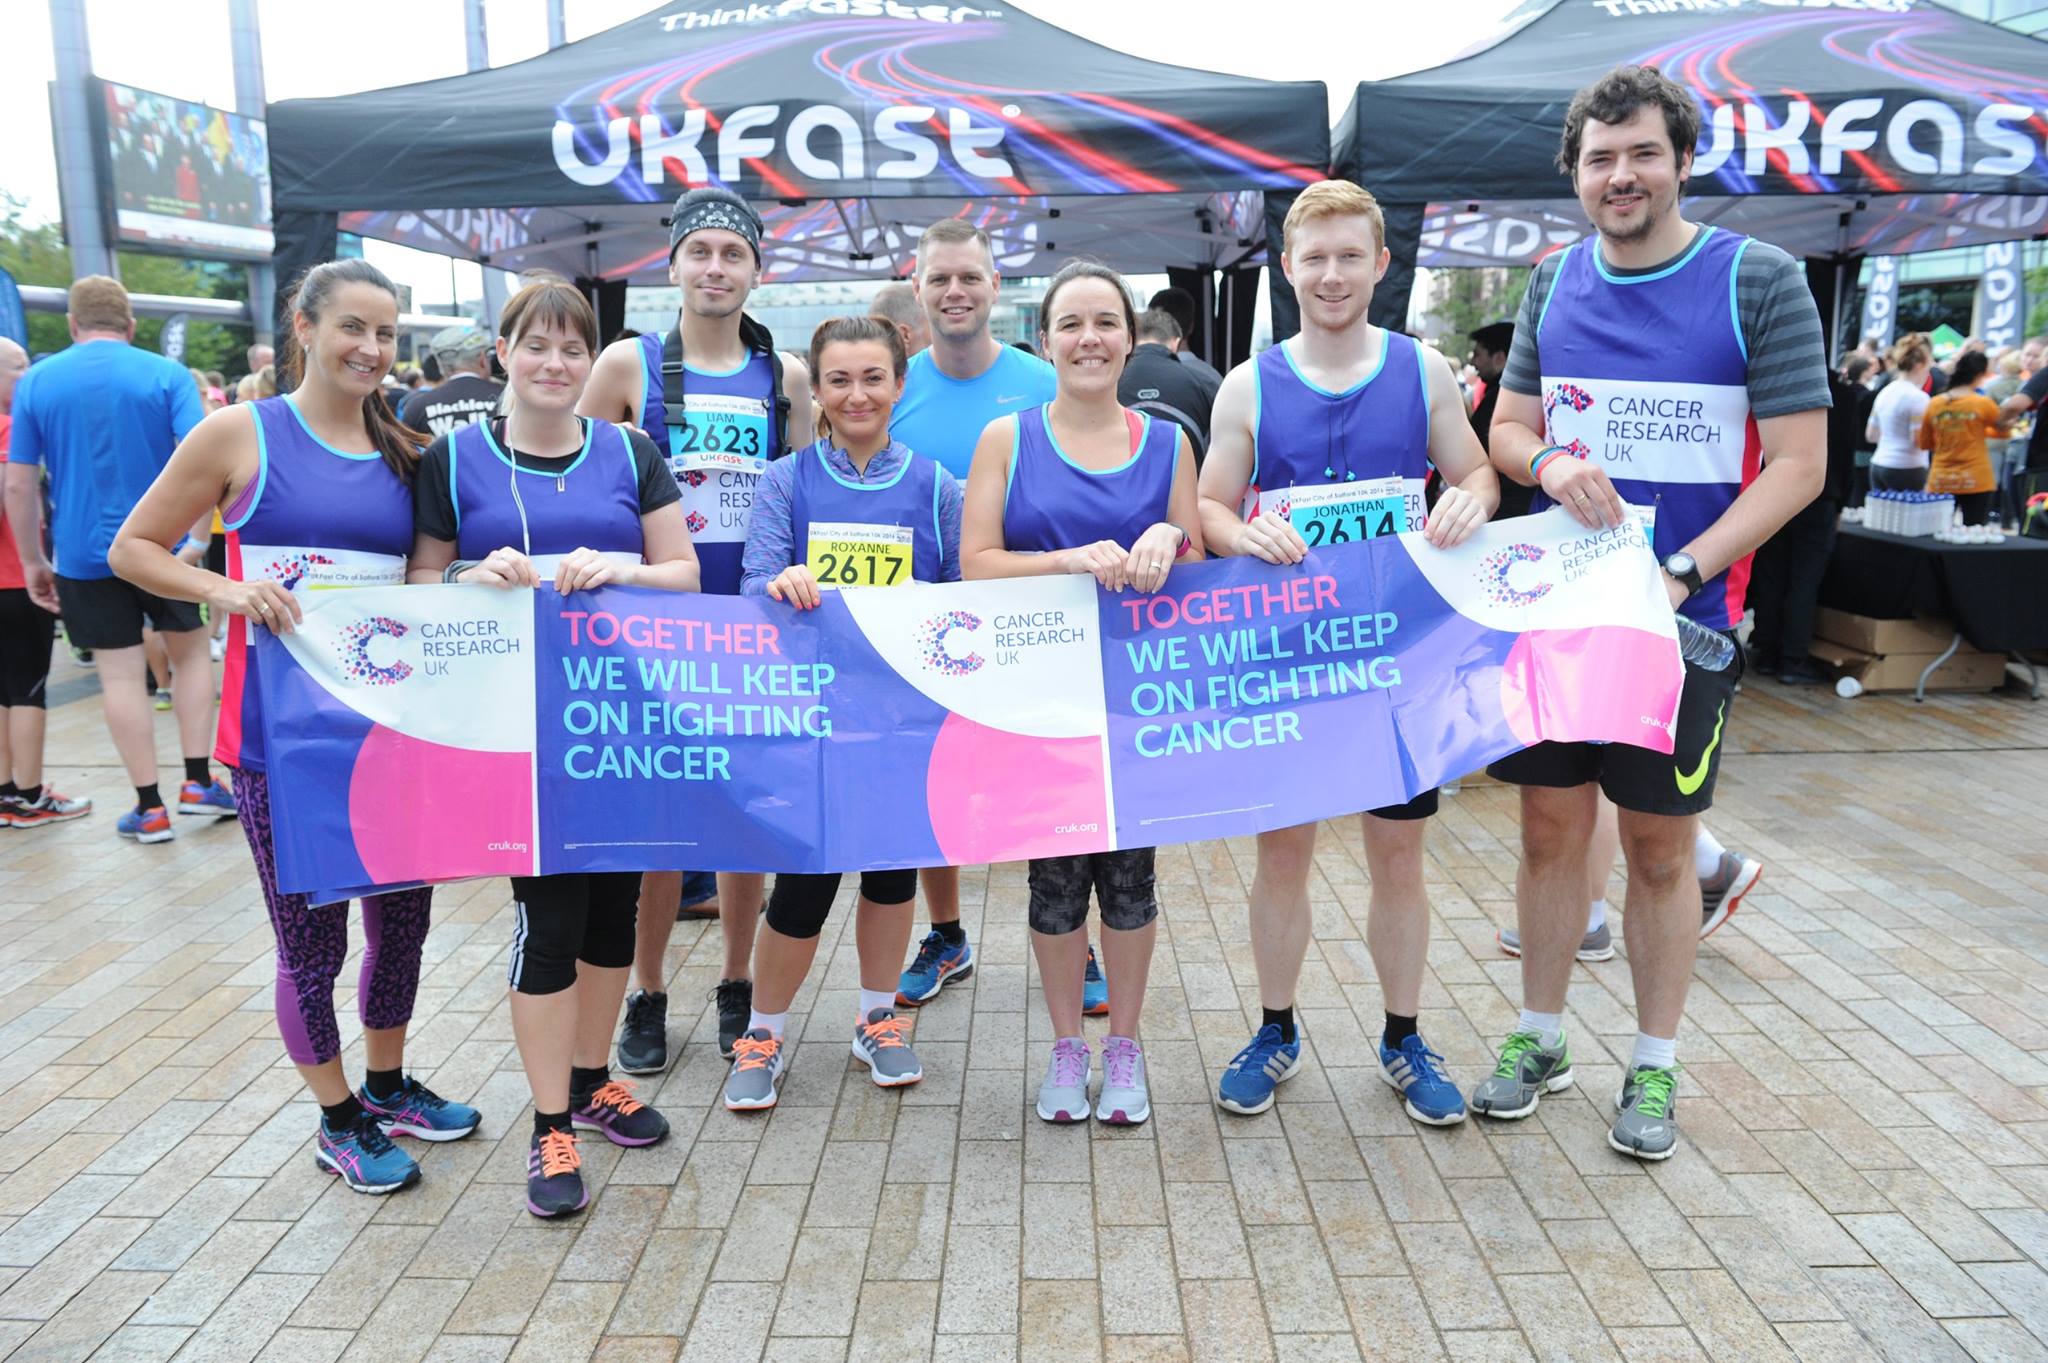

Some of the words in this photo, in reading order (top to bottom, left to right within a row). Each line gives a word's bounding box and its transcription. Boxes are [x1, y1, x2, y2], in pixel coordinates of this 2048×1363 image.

[425, 399, 496, 418] Blackley
[1608, 396, 1703, 419] CANCER
[706, 413, 735, 423] LIAM
[680, 424, 760, 457] 2623
[1606, 420, 1721, 444] RESEARCH
[1604, 443, 1634, 462] UK
[719, 472, 761, 488] CAN
[1313, 500, 1385, 518] JONATHAN
[720, 512, 744, 528] UK
[1304, 511, 1398, 547] 2614
[831, 542, 891, 554] ROXANNE
[1559, 523, 1633, 556] CANCER
[1562, 535, 1652, 571] RESEARCH
[817, 553, 903, 585] 2617
[1565, 566, 1590, 583] UK
[1121, 575, 1341, 632] TOGETHER
[420, 620, 499, 638] CANCER
[994, 611, 1065, 630] CANCER
[560, 611, 781, 655] TOGETHER
[995, 627, 1085, 648] RESEARCH
[1125, 637, 1190, 674] WE
[1198, 624, 1293, 666] WILL
[1304, 611, 1399, 654] KEEP
[423, 638, 520, 657] RESEARCH
[424, 660, 449, 676] UK
[996, 650, 1020, 666] UK
[562, 656, 628, 691] WE
[637, 657, 732, 695] WILL
[743, 663, 836, 697] KEEP
[1130, 681, 1195, 717] ON
[1208, 655, 1402, 710] FIGHTING
[563, 700, 629, 736] ON
[642, 702, 832, 738] FIGHTING
[1640, 715, 1672, 730] cruk.o
[1135, 711, 1303, 759] CANCER
[564, 744, 731, 780] CANCER
[1054, 822, 1098, 835] cruk.org
[488, 840, 527, 853] cruk.org
